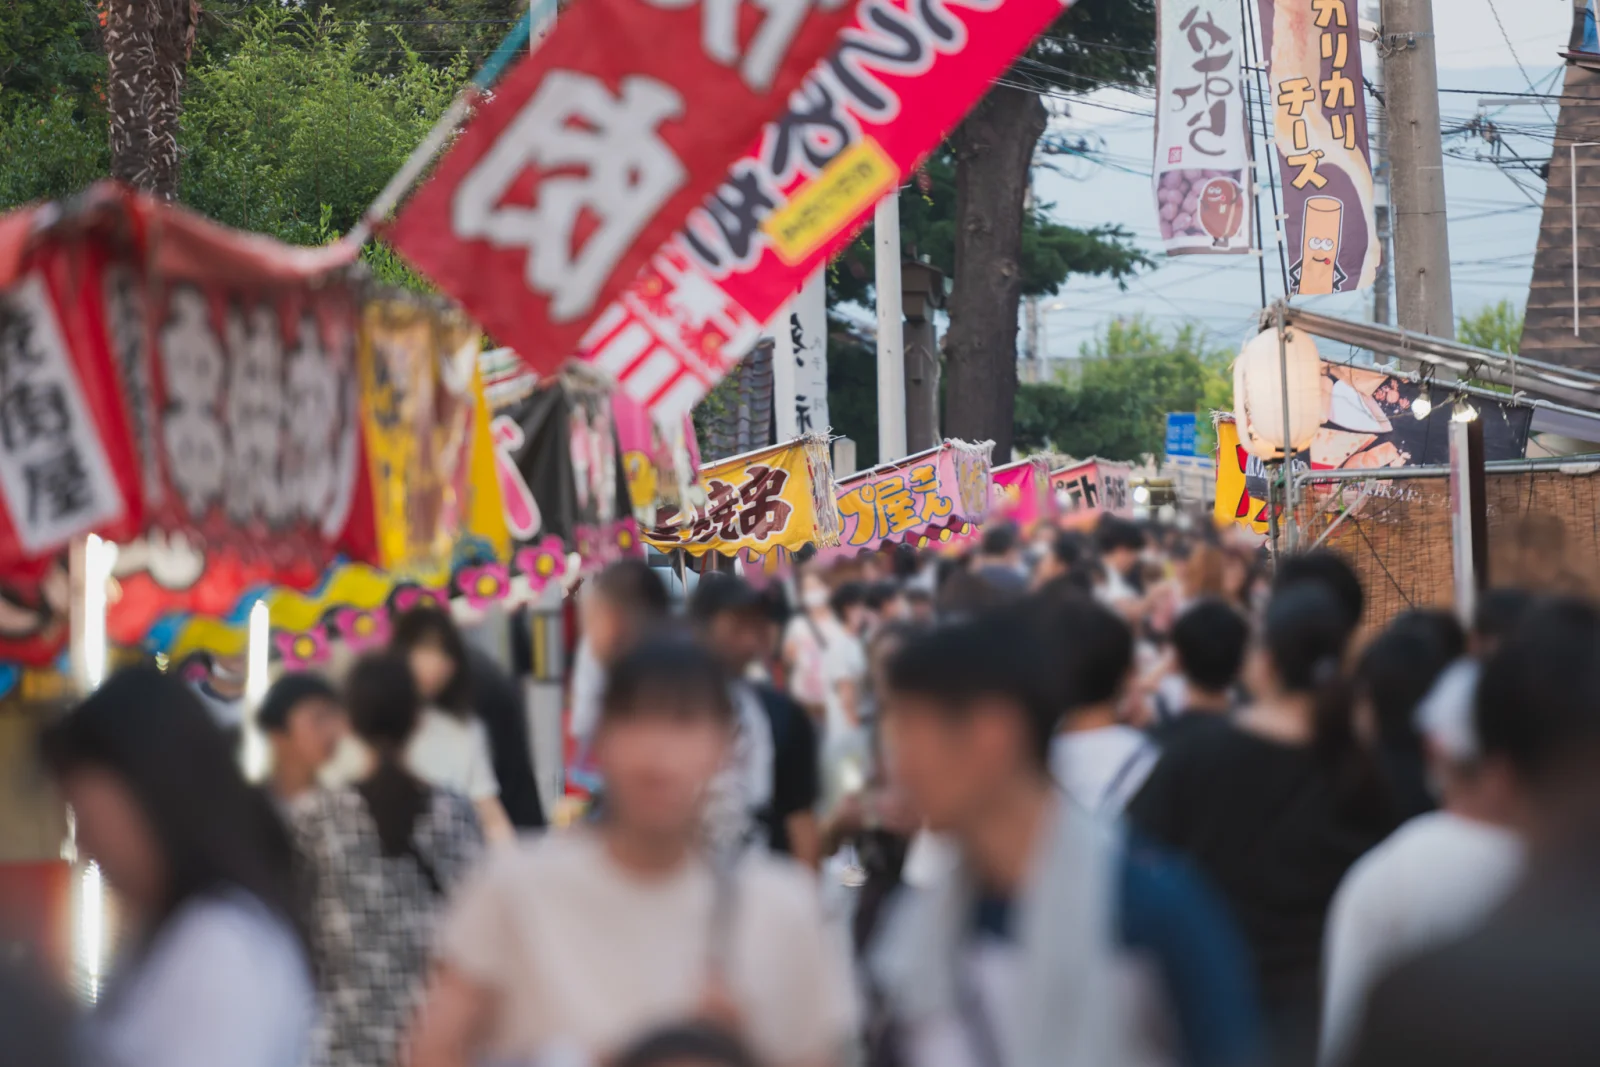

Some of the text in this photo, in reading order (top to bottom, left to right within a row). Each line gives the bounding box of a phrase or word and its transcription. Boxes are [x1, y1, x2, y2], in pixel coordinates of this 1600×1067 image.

[1313, 0, 1357, 150] カリカリ
[1277, 76, 1329, 190] チーズ
[838, 464, 953, 546] プ屋さん
